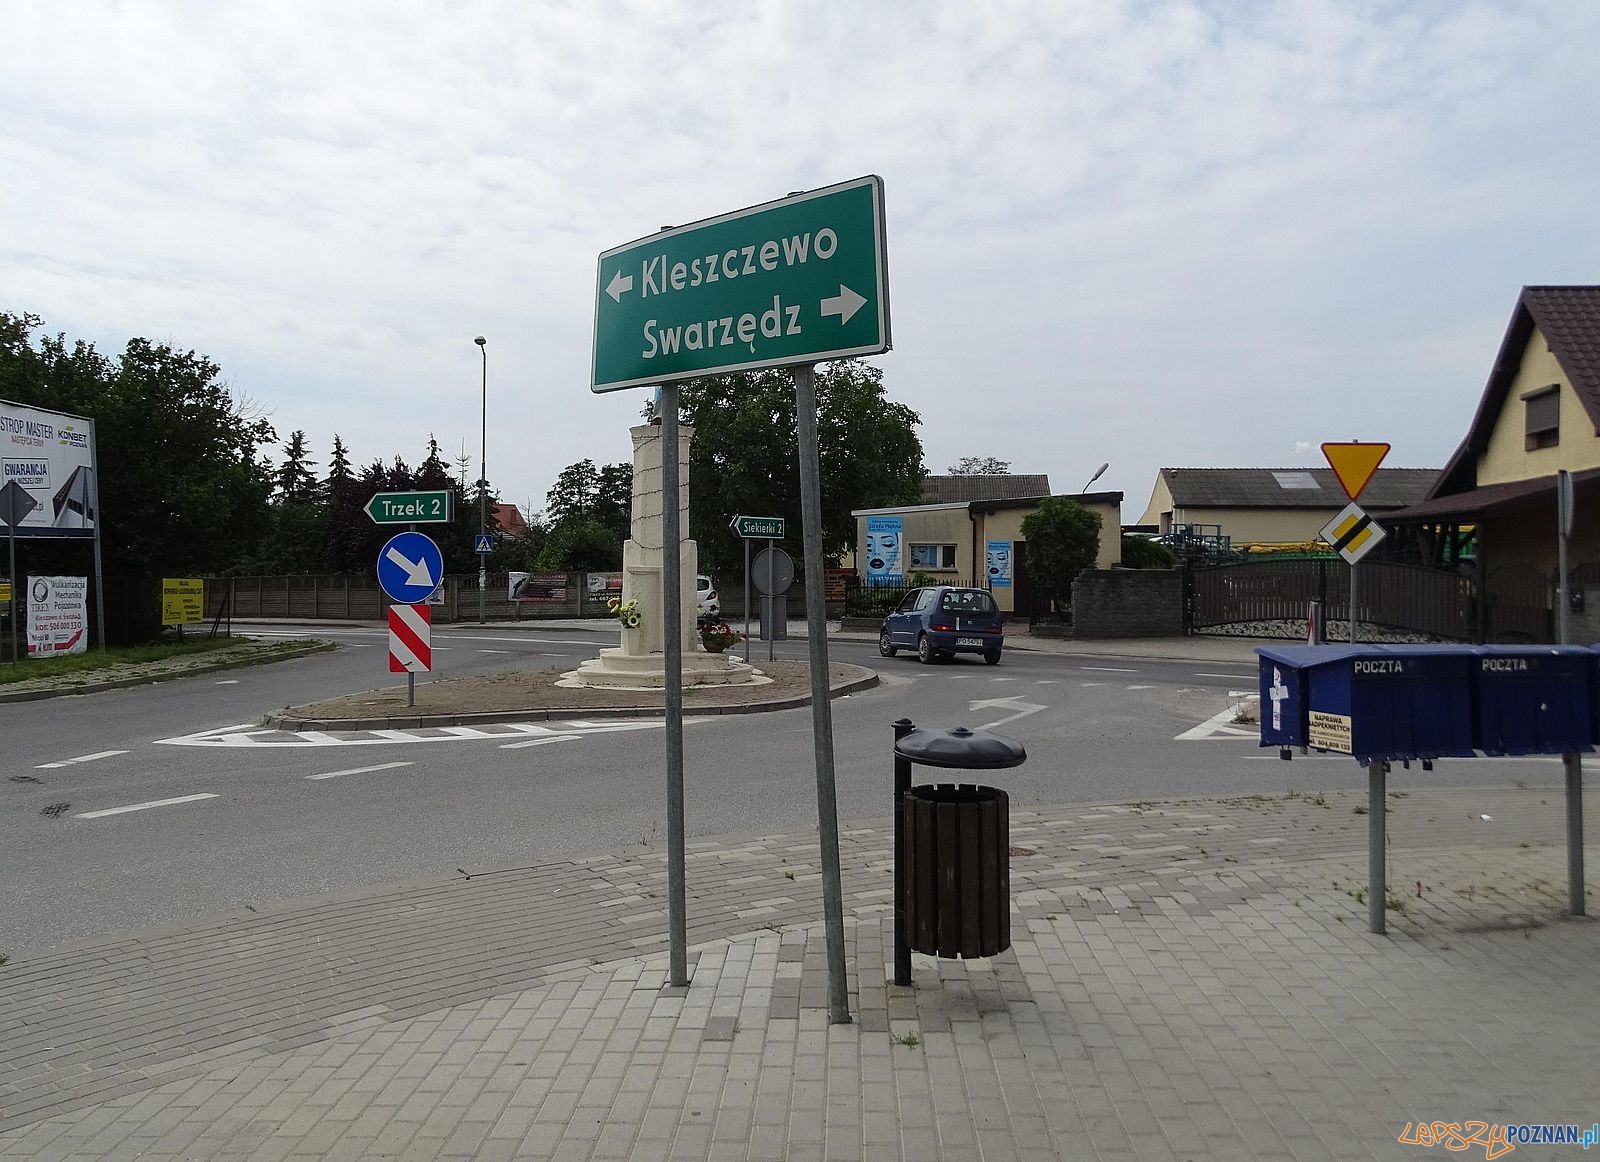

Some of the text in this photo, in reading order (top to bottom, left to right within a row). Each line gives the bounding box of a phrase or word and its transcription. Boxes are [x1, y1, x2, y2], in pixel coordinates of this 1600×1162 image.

[641, 228, 838, 298] Kleszczewo
[641, 295, 802, 359] Swarzędz
[0, 416, 54, 439] STROP MASTER
[57, 430, 87, 443] KONBET
[4, 463, 48, 476] GWARANCJA
[382, 498, 441, 516] Trzek 2
[744, 521, 782, 534] Siekierki 2
[50, 580, 85, 591] Wulkanizacja
[54, 590, 82, 599] Mechanika
[54, 600, 82, 612] Pojazdowa
[1354, 660, 1402, 674] POCZTA
[1482, 658, 1528, 671] POCZTA
[1314, 713, 1343, 724] NAPRAWA
